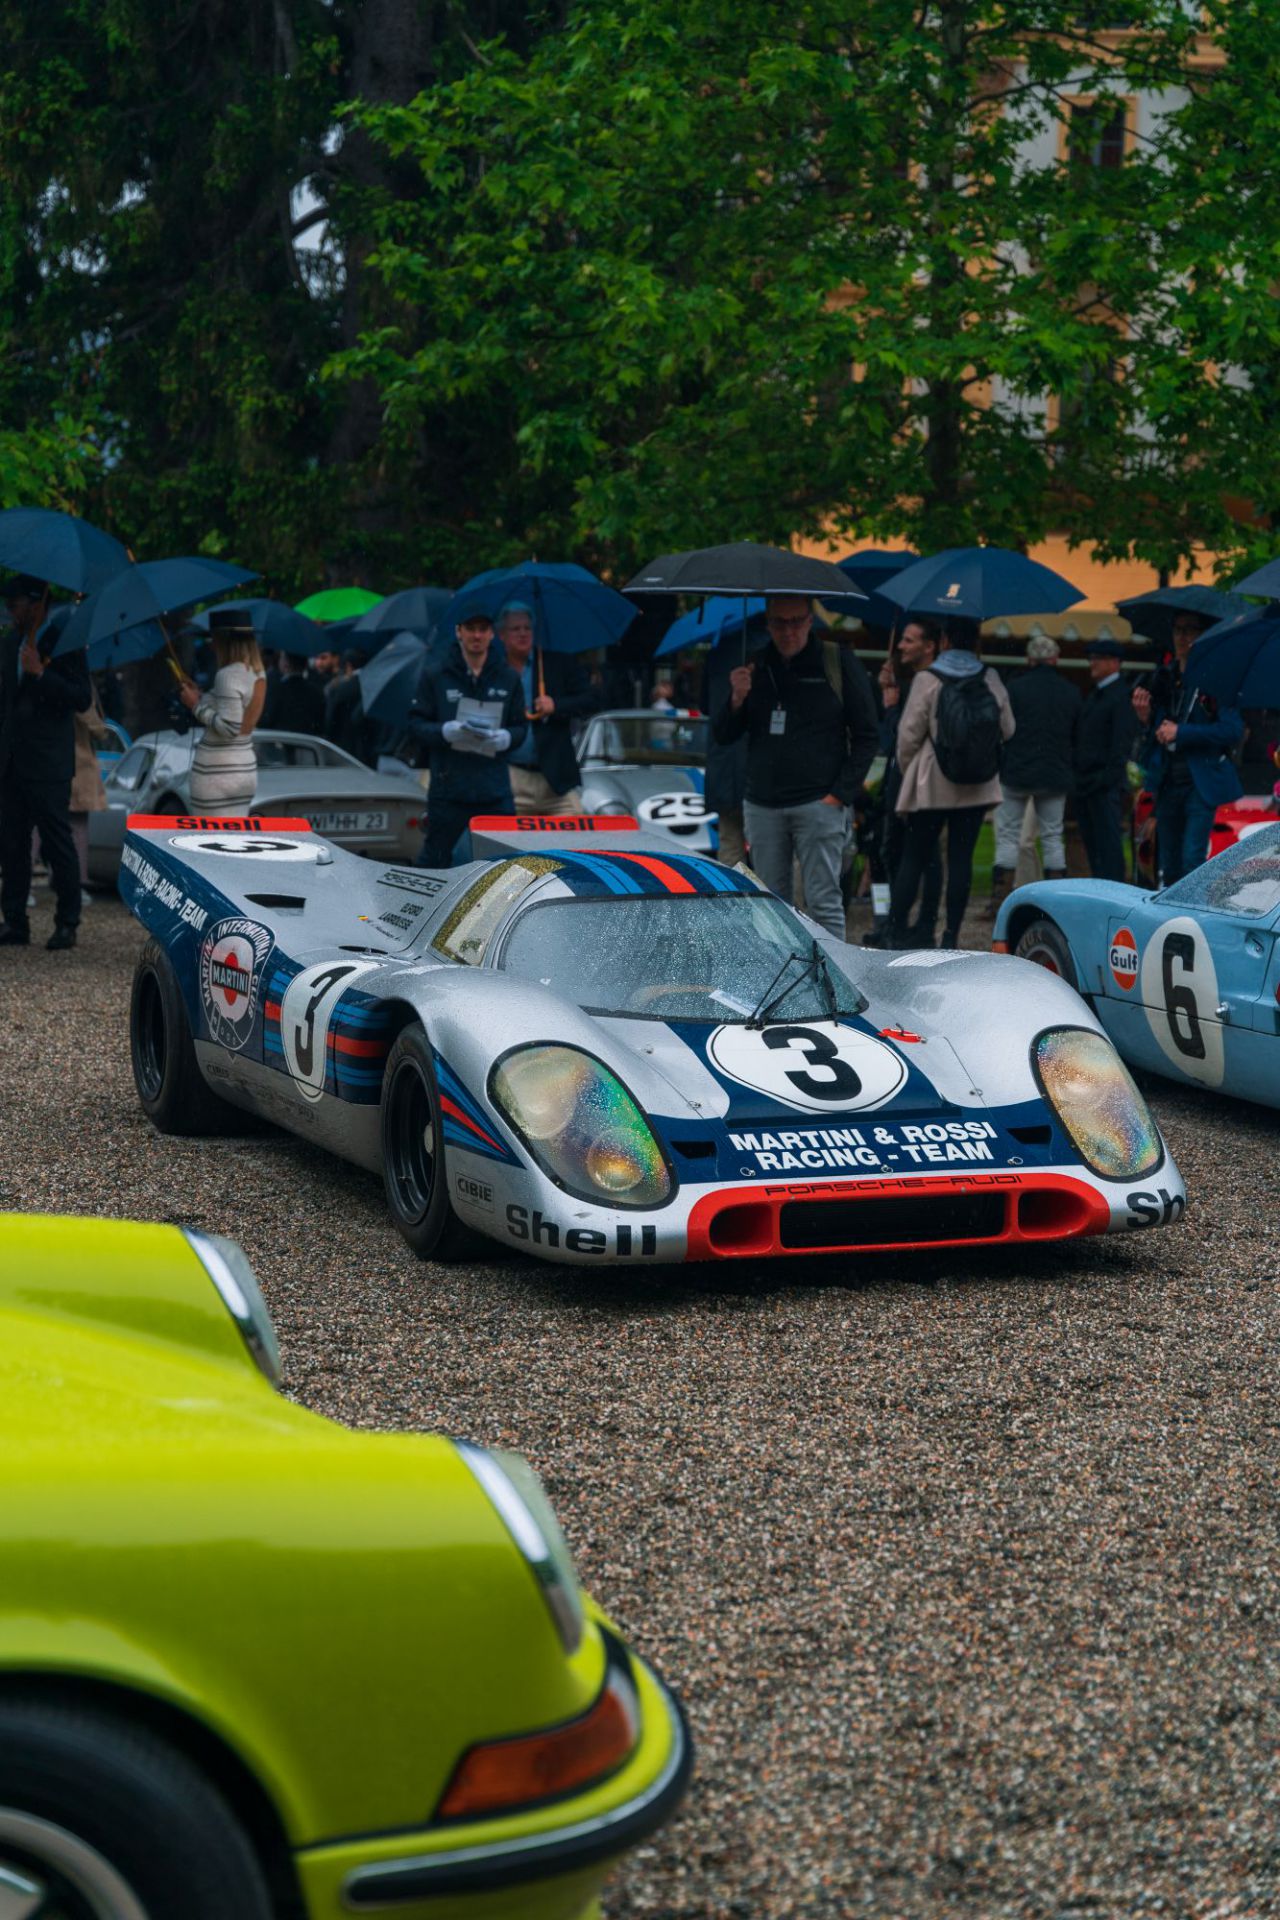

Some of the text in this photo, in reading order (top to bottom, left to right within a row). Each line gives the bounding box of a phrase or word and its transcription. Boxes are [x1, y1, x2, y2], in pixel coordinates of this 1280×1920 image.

[366, 813, 384, 828] 23
[650, 797, 707, 820] 25
[176, 818, 262, 831] Shell
[516, 818, 594, 831] Shell
[154, 878, 183, 910] RACING
[178, 898, 208, 931] TEAM
[202, 932, 214, 1006] MARTINI
[217, 920, 270, 968] INTERNATIONAL
[1111, 949, 1137, 970] Gulf
[212, 964, 249, 994] MARTINI
[1162, 932, 1206, 1060] 6
[295, 966, 357, 1077] 3
[761, 1026, 862, 1101] 3
[729, 1121, 998, 1152] MARTINI & ROSSI
[754, 1148, 881, 1171] RACING
[900, 1141, 994, 1163] TEAM
[457, 1176, 492, 1201] CIBIE
[506, 1203, 657, 1256] Shell
